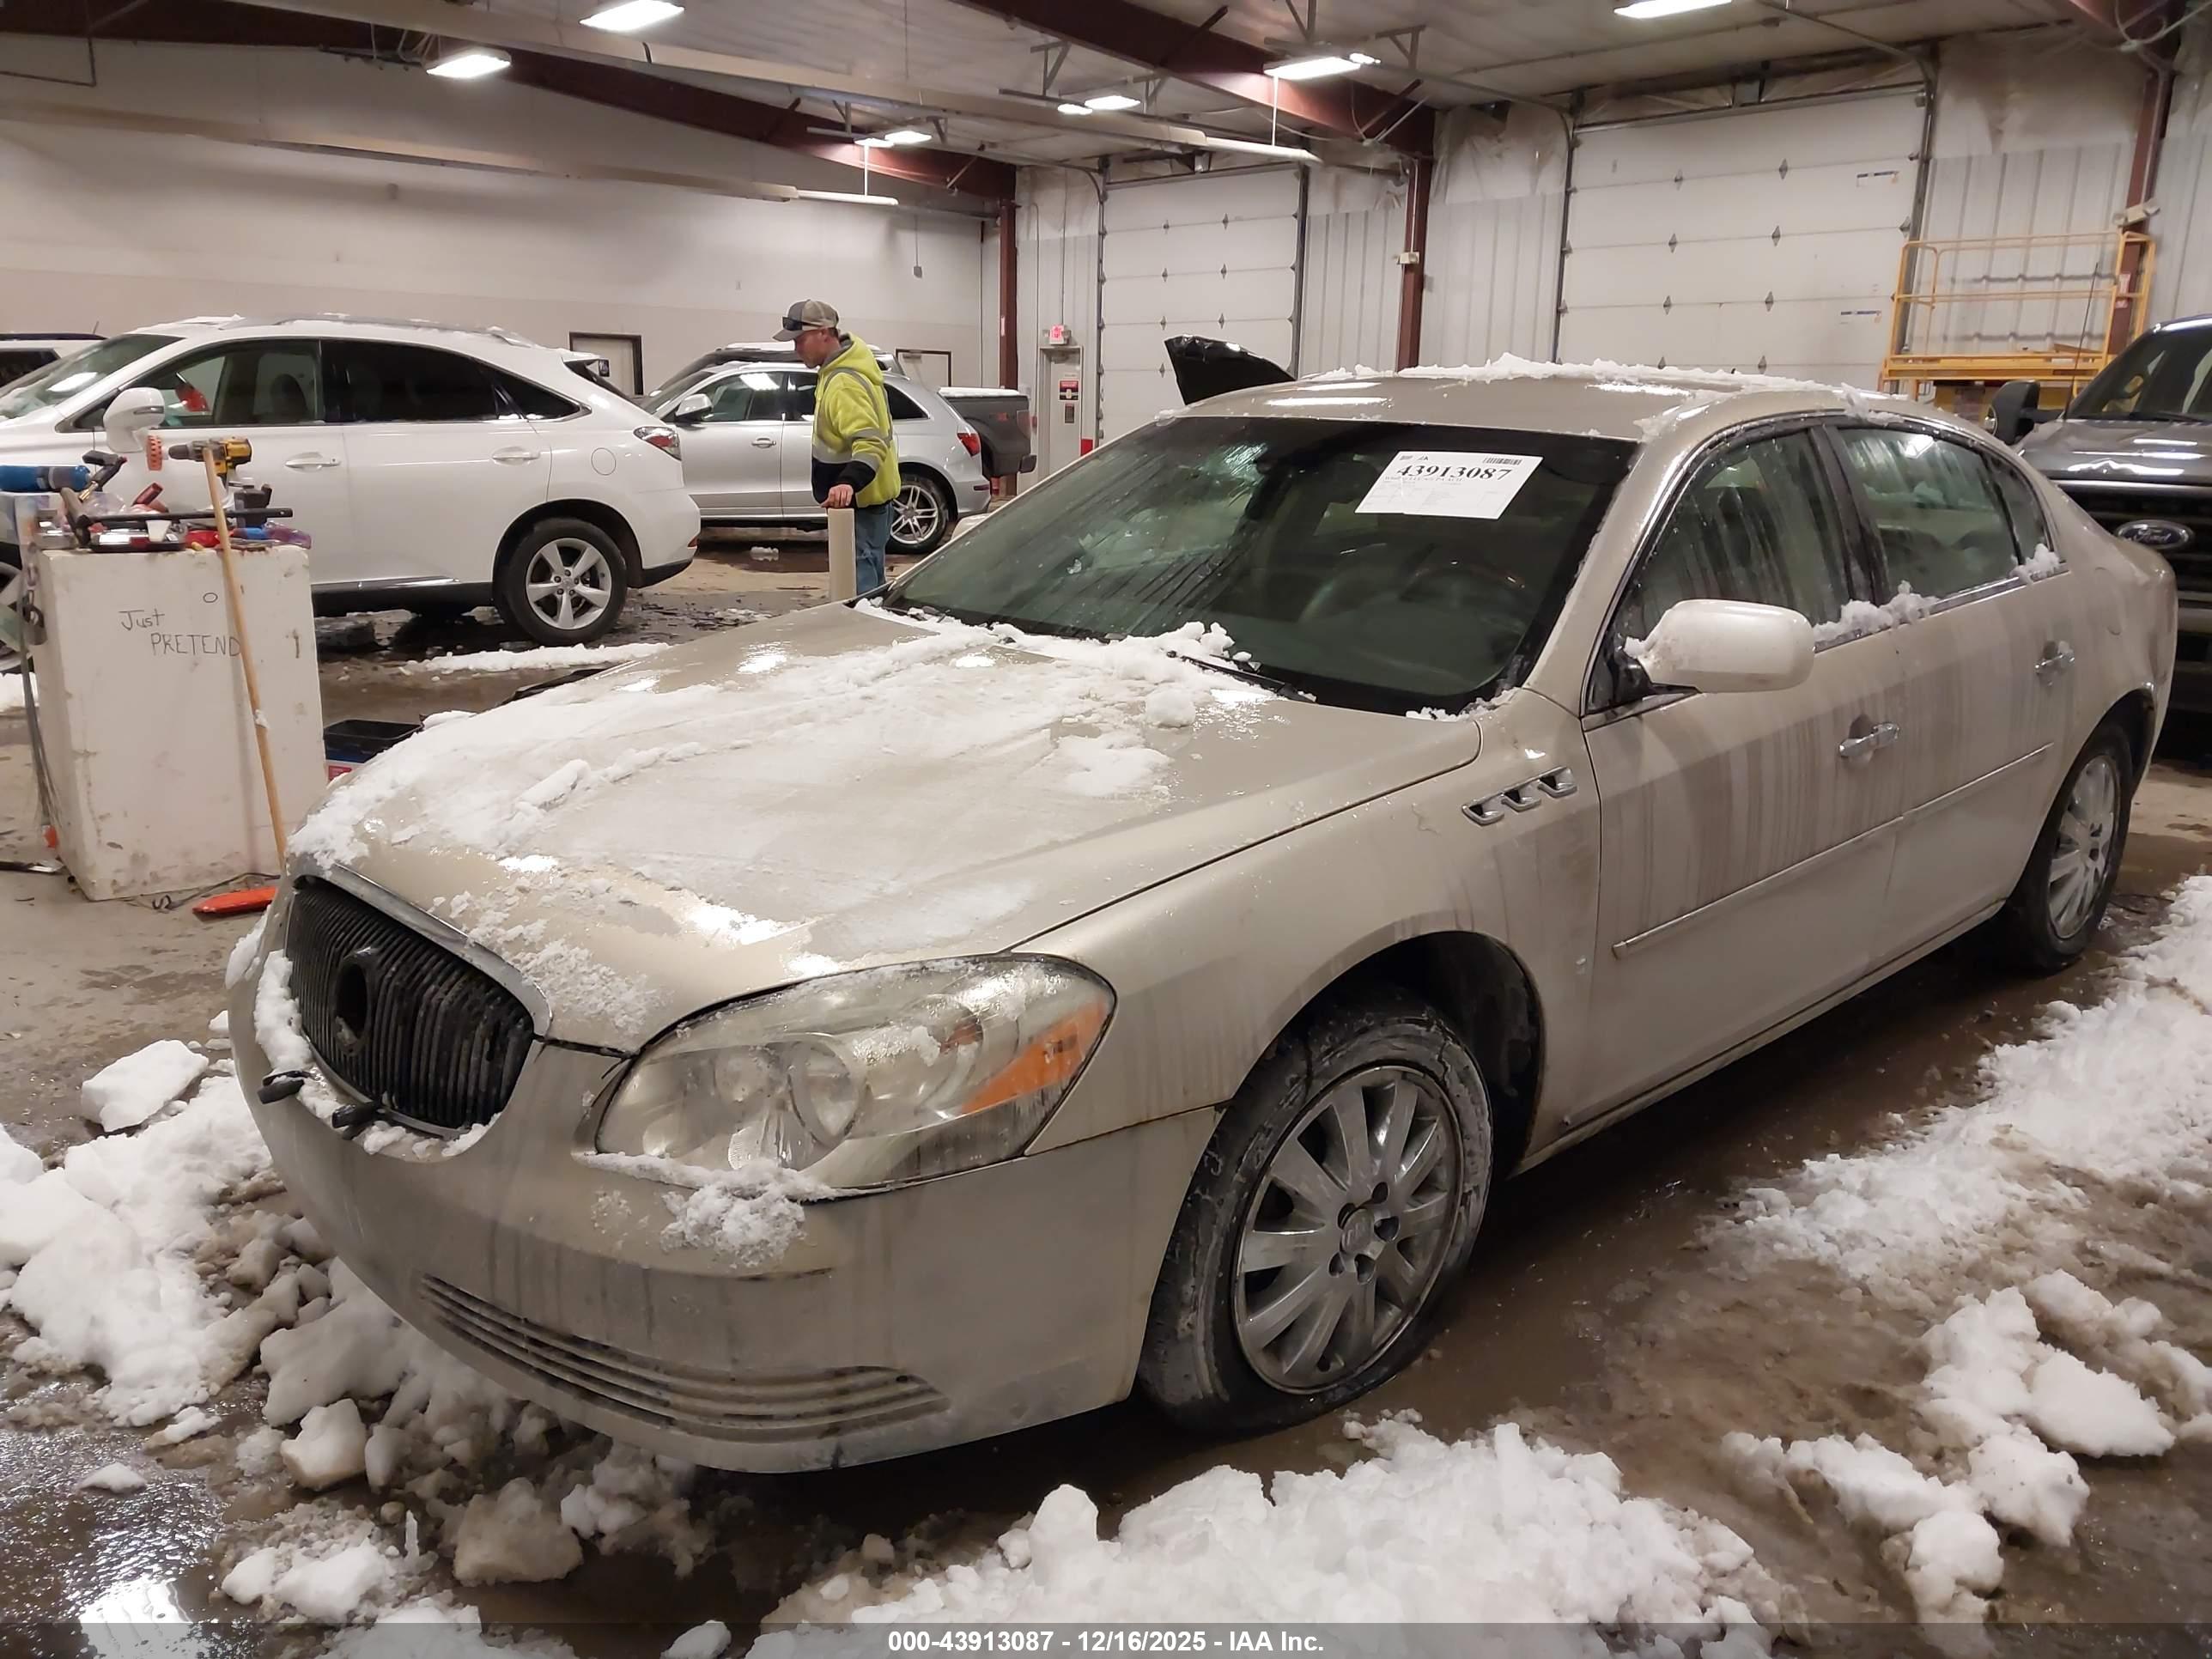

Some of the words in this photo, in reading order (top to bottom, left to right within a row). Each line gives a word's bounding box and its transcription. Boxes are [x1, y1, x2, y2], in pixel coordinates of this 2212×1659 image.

[1397, 465, 1512, 481] 43913087
[118, 608, 166, 631] Just
[150, 632, 241, 657] PRETEND
